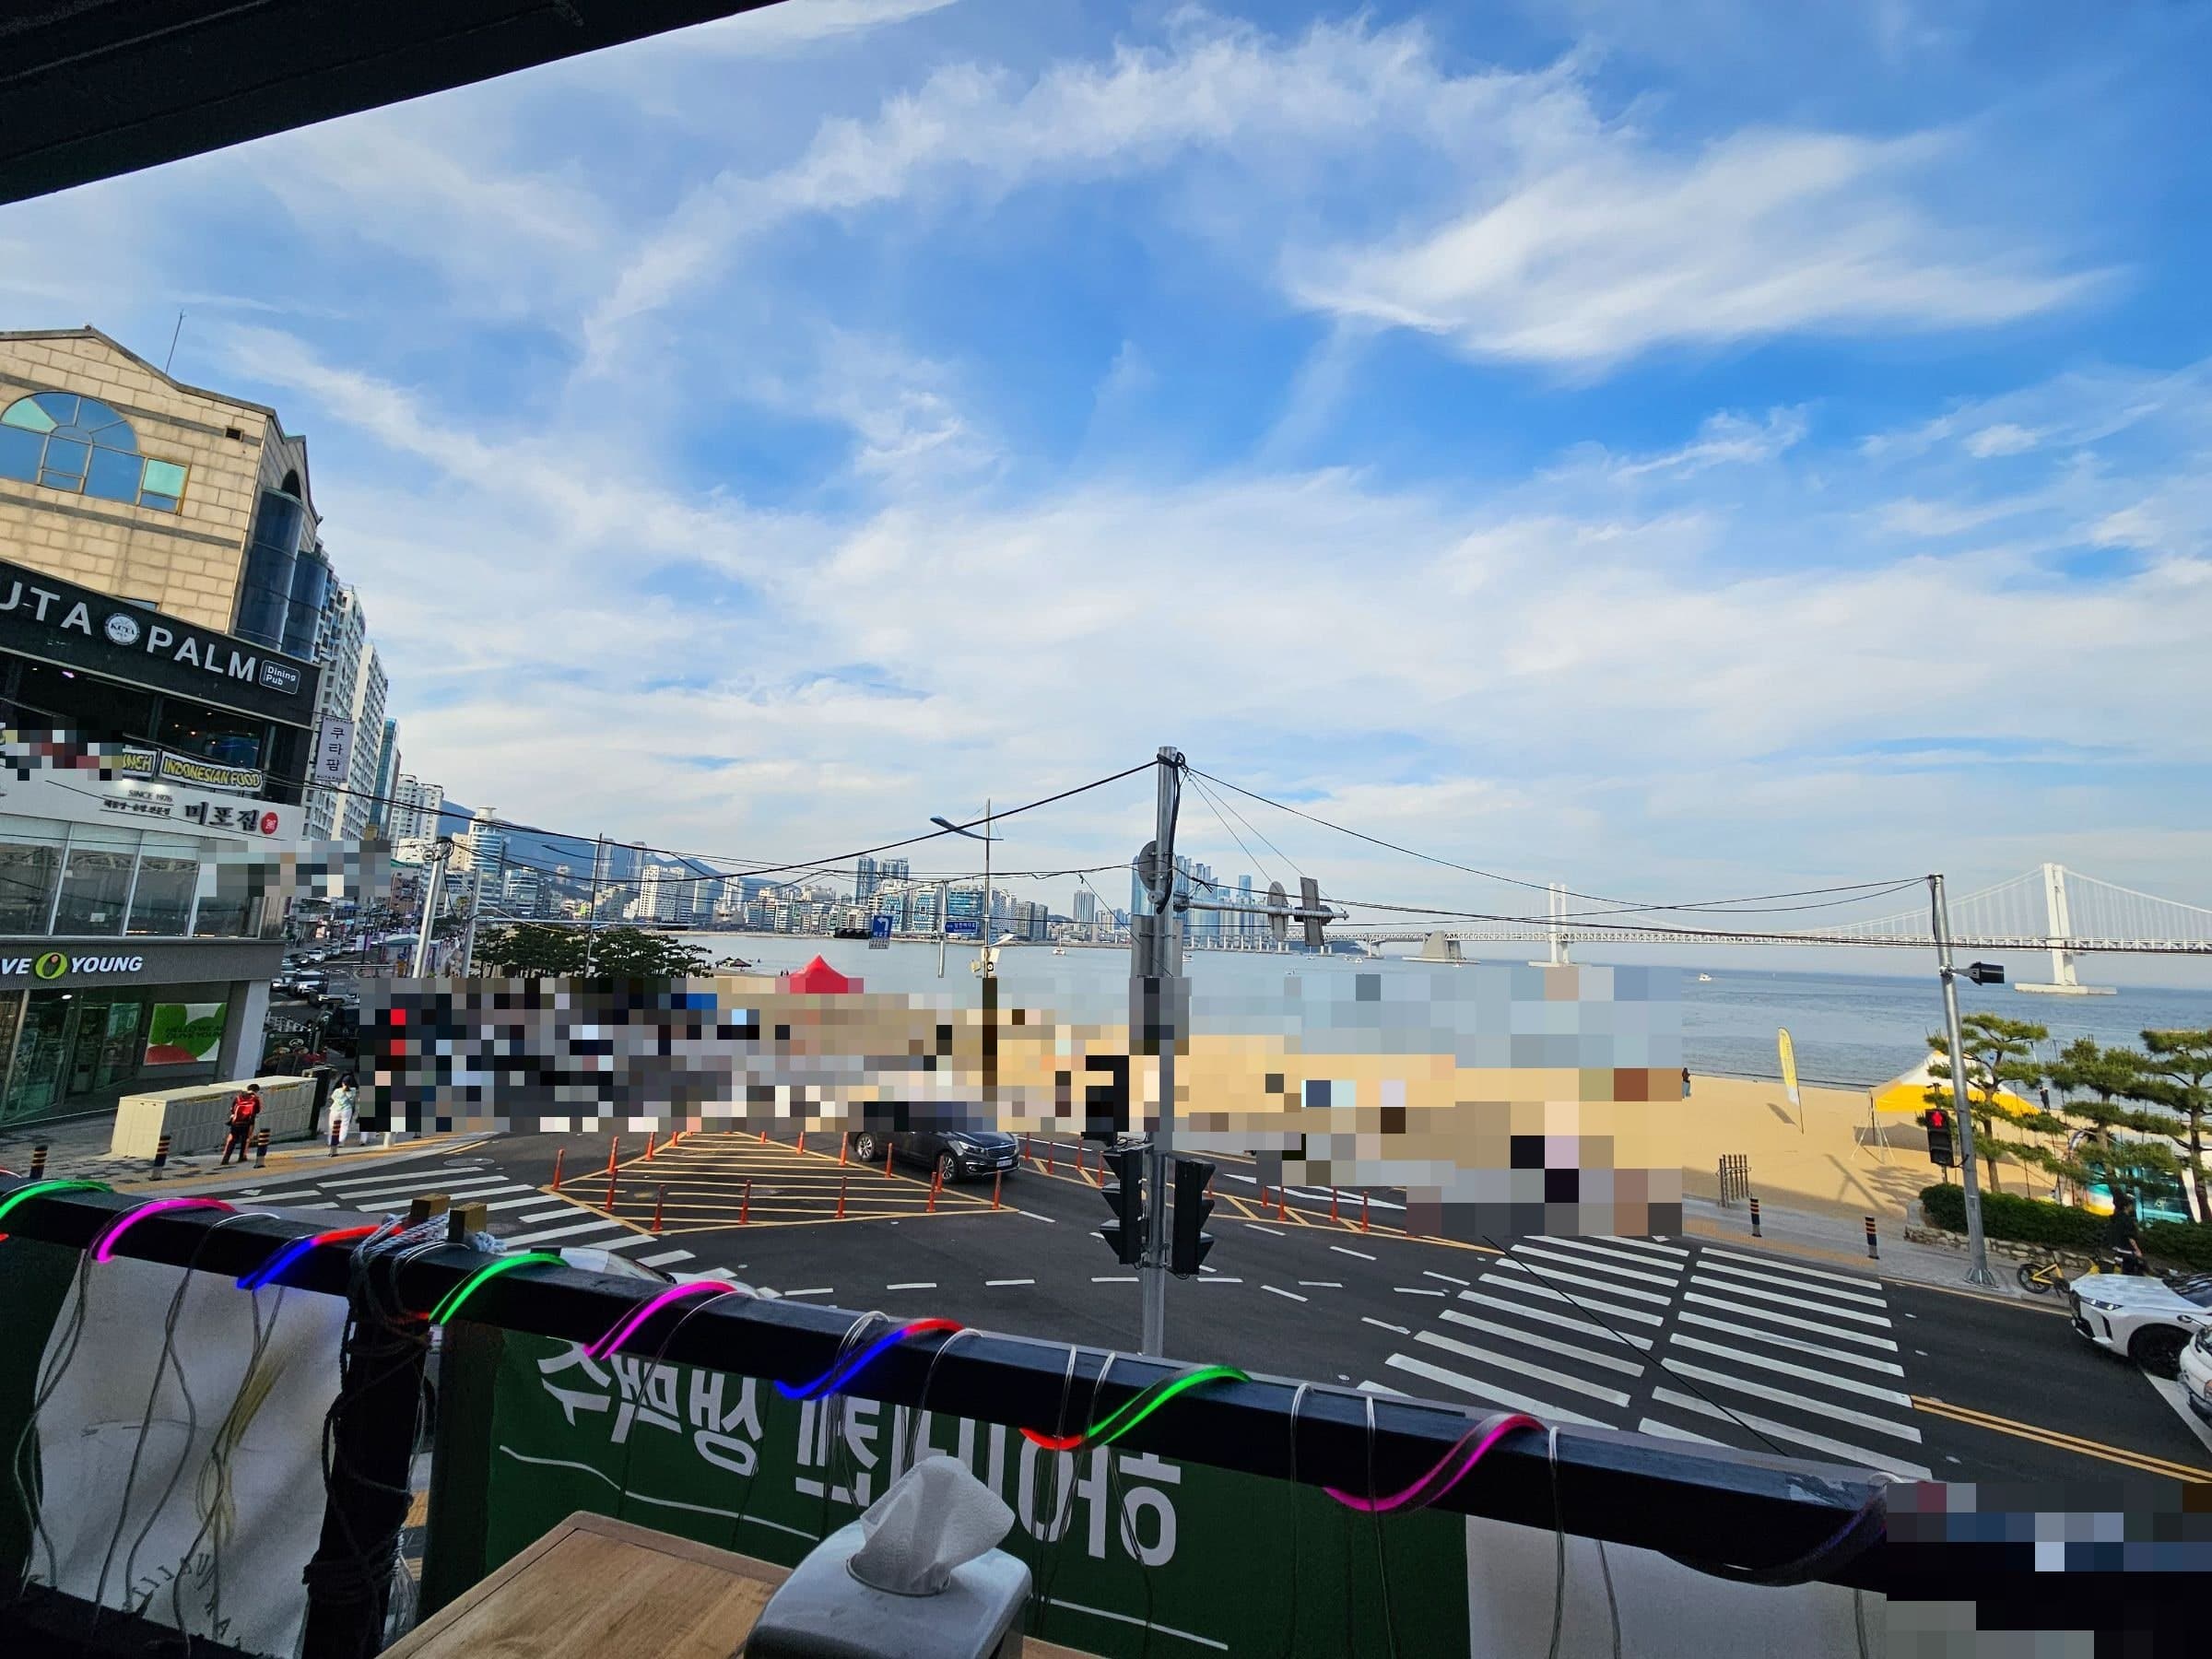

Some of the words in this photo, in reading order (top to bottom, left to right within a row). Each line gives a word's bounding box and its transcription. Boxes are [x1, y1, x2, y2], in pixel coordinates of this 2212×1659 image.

[146, 625, 256, 683] PALM
[265, 674, 283, 687] Pub
[266, 665, 297, 682] Dining
[325, 726, 346, 771] 쿠타팜
[163, 758, 229, 785] INDONESIAN
[230, 771, 262, 788] FOOD
[128, 790, 152, 800] SINCE
[184, 801, 260, 831] 미포집
[71, 956, 144, 974] YOUNG
